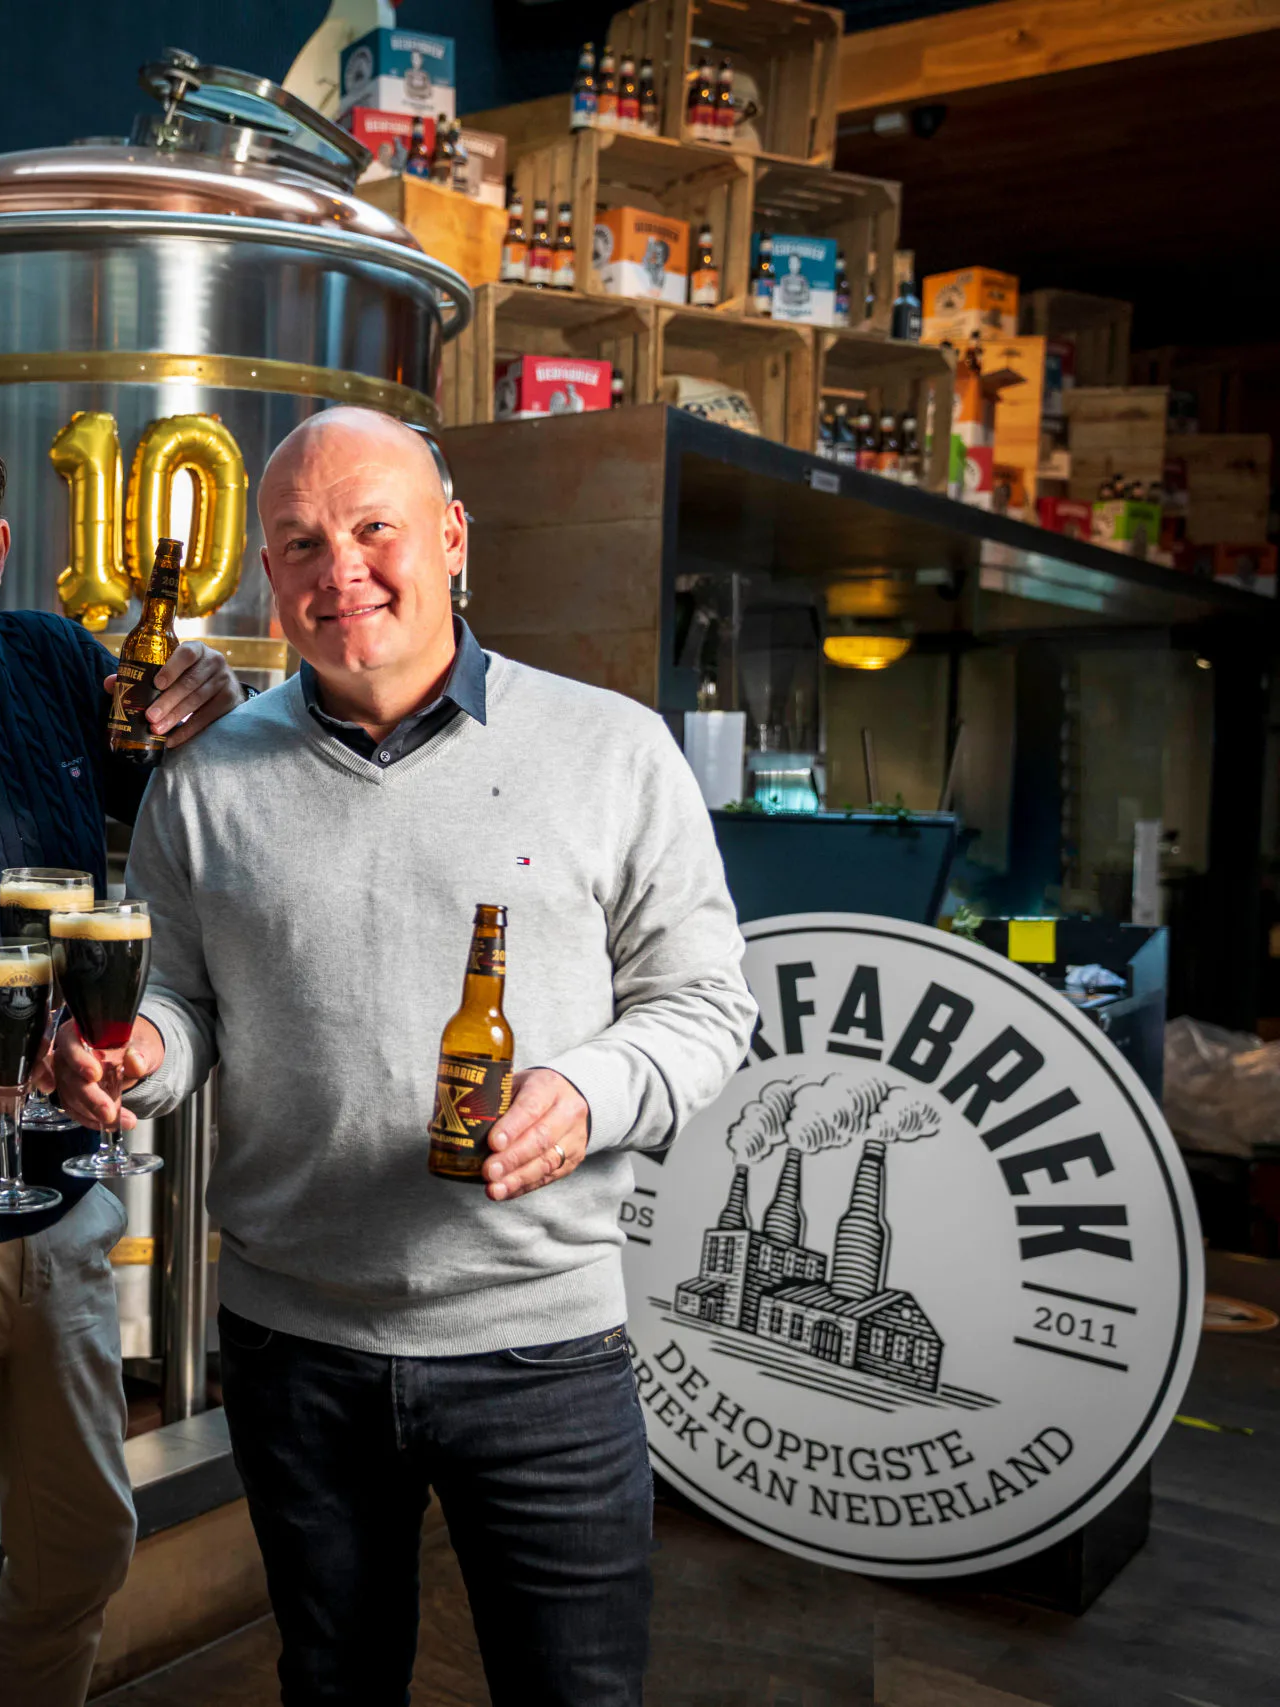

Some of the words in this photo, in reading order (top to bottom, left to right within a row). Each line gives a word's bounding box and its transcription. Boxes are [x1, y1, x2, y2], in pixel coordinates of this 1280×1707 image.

[49, 411, 249, 620] 10
[619, 1202, 654, 1228] DS
[1034, 1307, 1118, 1349] 2011
[654, 1340, 710, 1401] DE
[707, 1391, 975, 1482] HOPPIGSTE
[714, 1439, 799, 1506] VAN
[808, 1426, 1074, 1527] NEDERLAND
